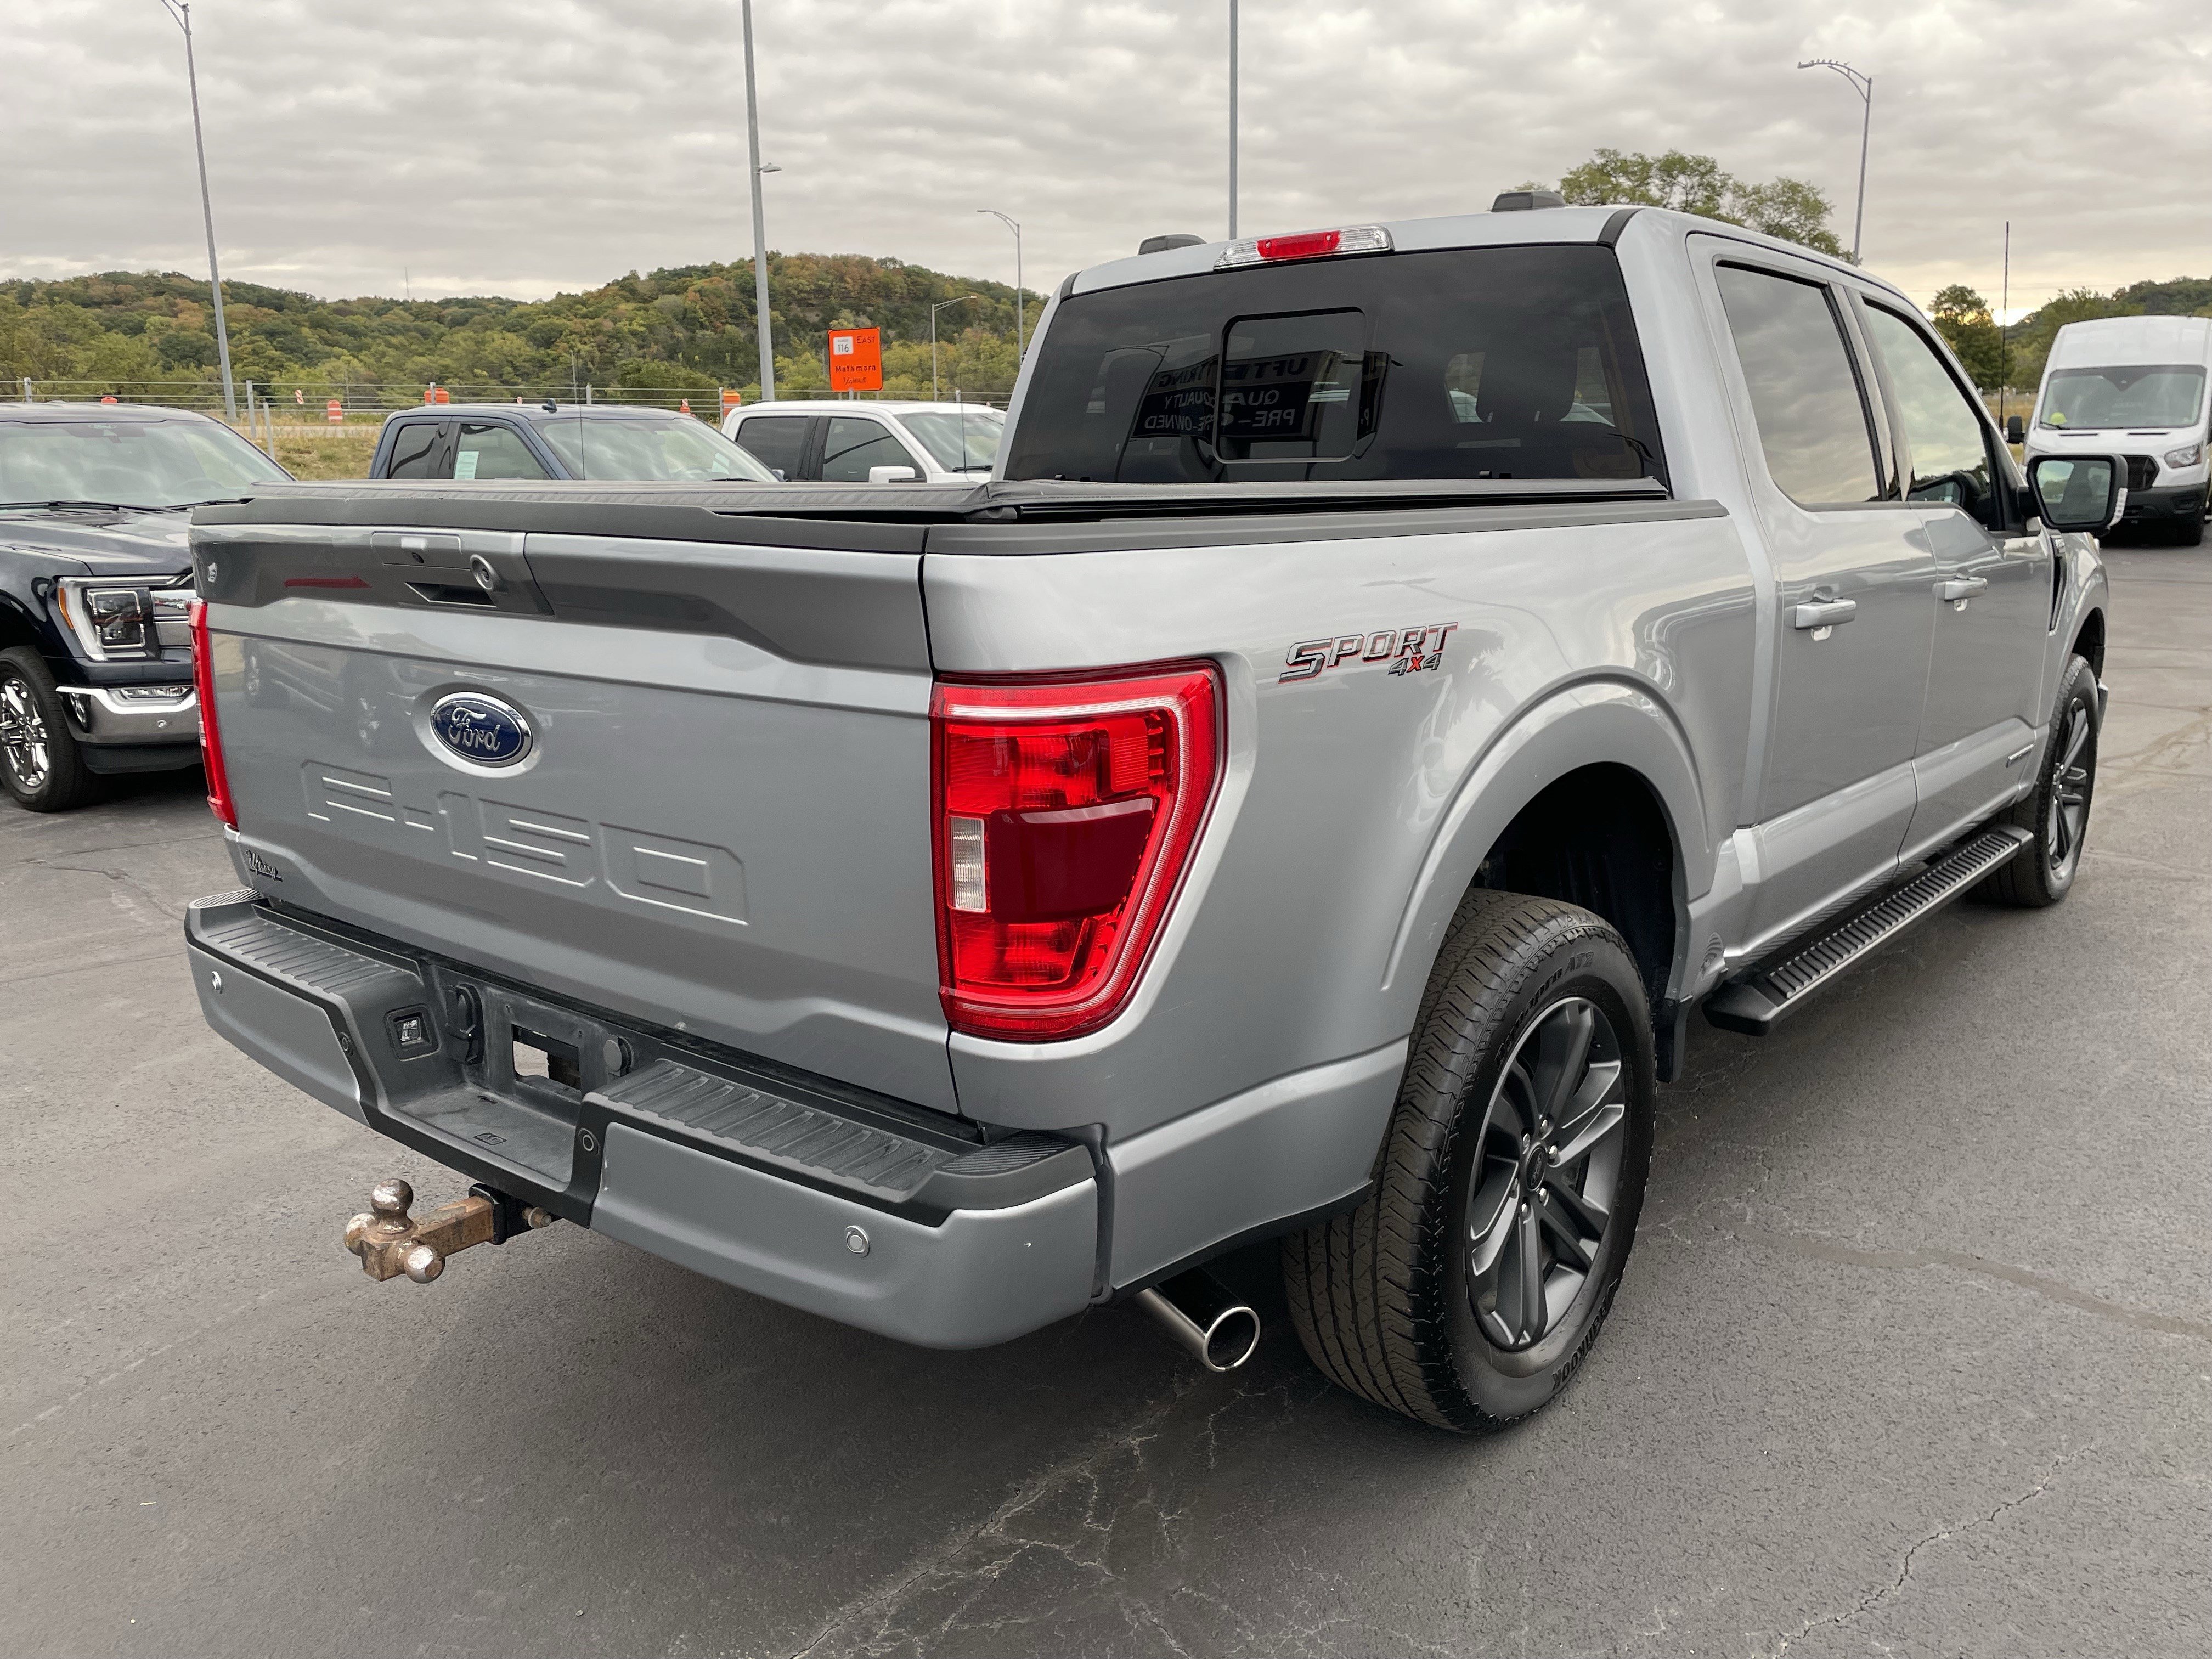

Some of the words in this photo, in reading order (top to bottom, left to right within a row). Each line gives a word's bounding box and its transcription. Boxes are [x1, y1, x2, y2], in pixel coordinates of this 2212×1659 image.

[838, 343, 849, 352] 116
[1277, 621, 1458, 684] SPORT
[448, 707, 501, 752] Ford
[301, 759, 749, 926] F-150
[1565, 951, 1594, 974] AT2
